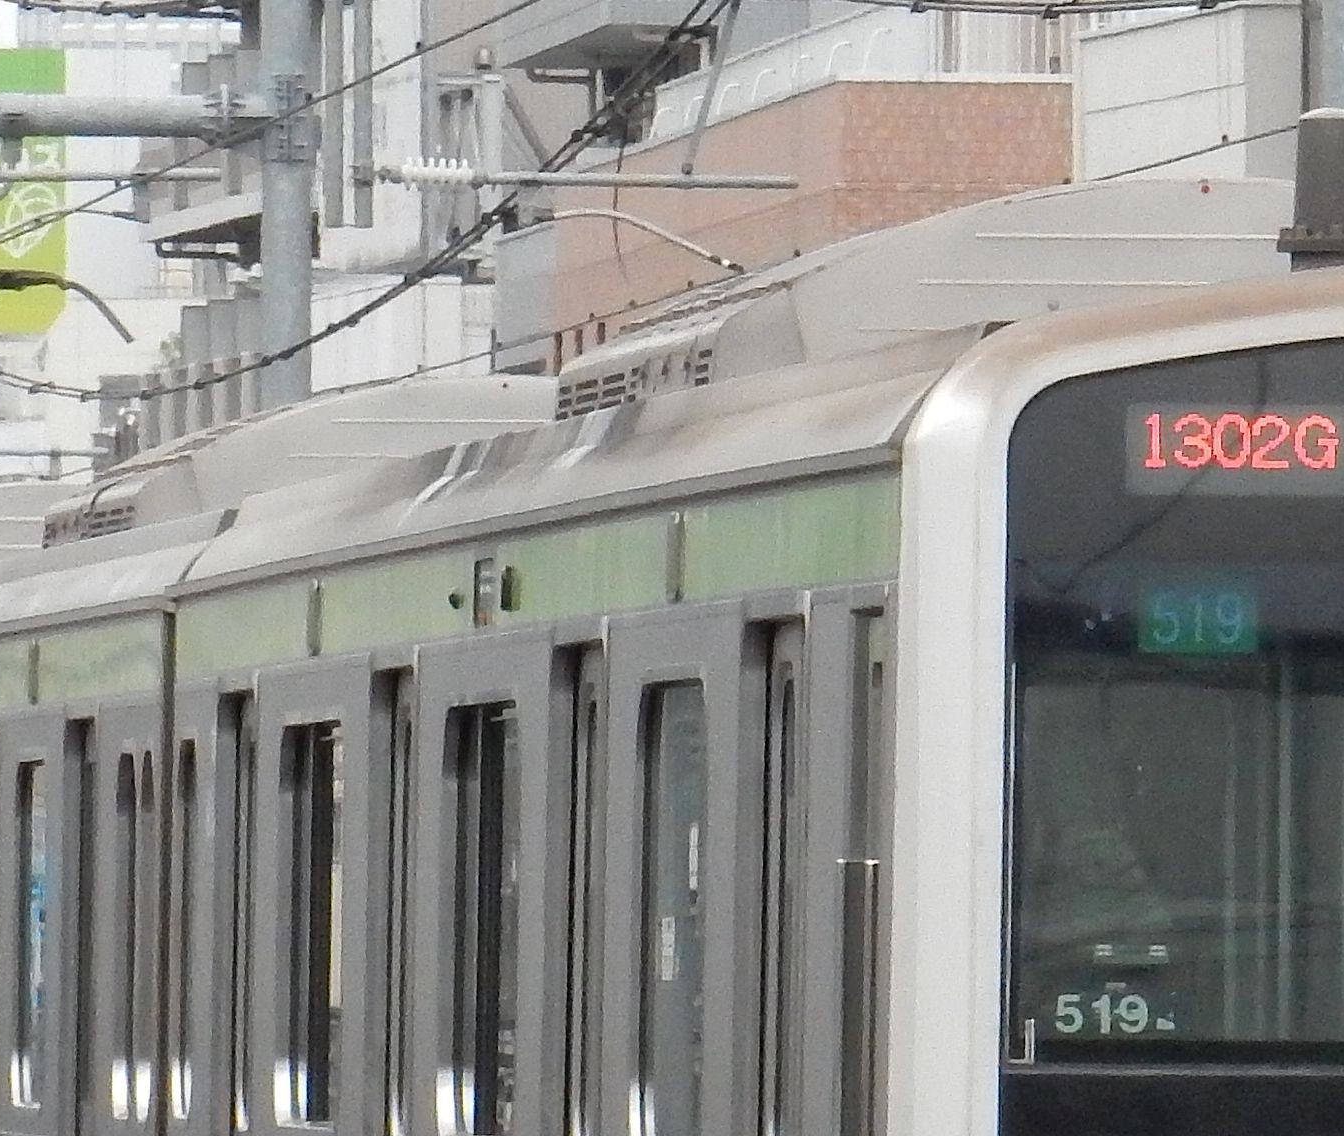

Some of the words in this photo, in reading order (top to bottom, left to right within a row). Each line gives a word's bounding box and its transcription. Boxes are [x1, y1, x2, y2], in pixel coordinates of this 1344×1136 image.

[1144, 412, 1340, 469] 1302G
[1152, 592, 1242, 643] 519
[1055, 993, 1149, 1034] 519
